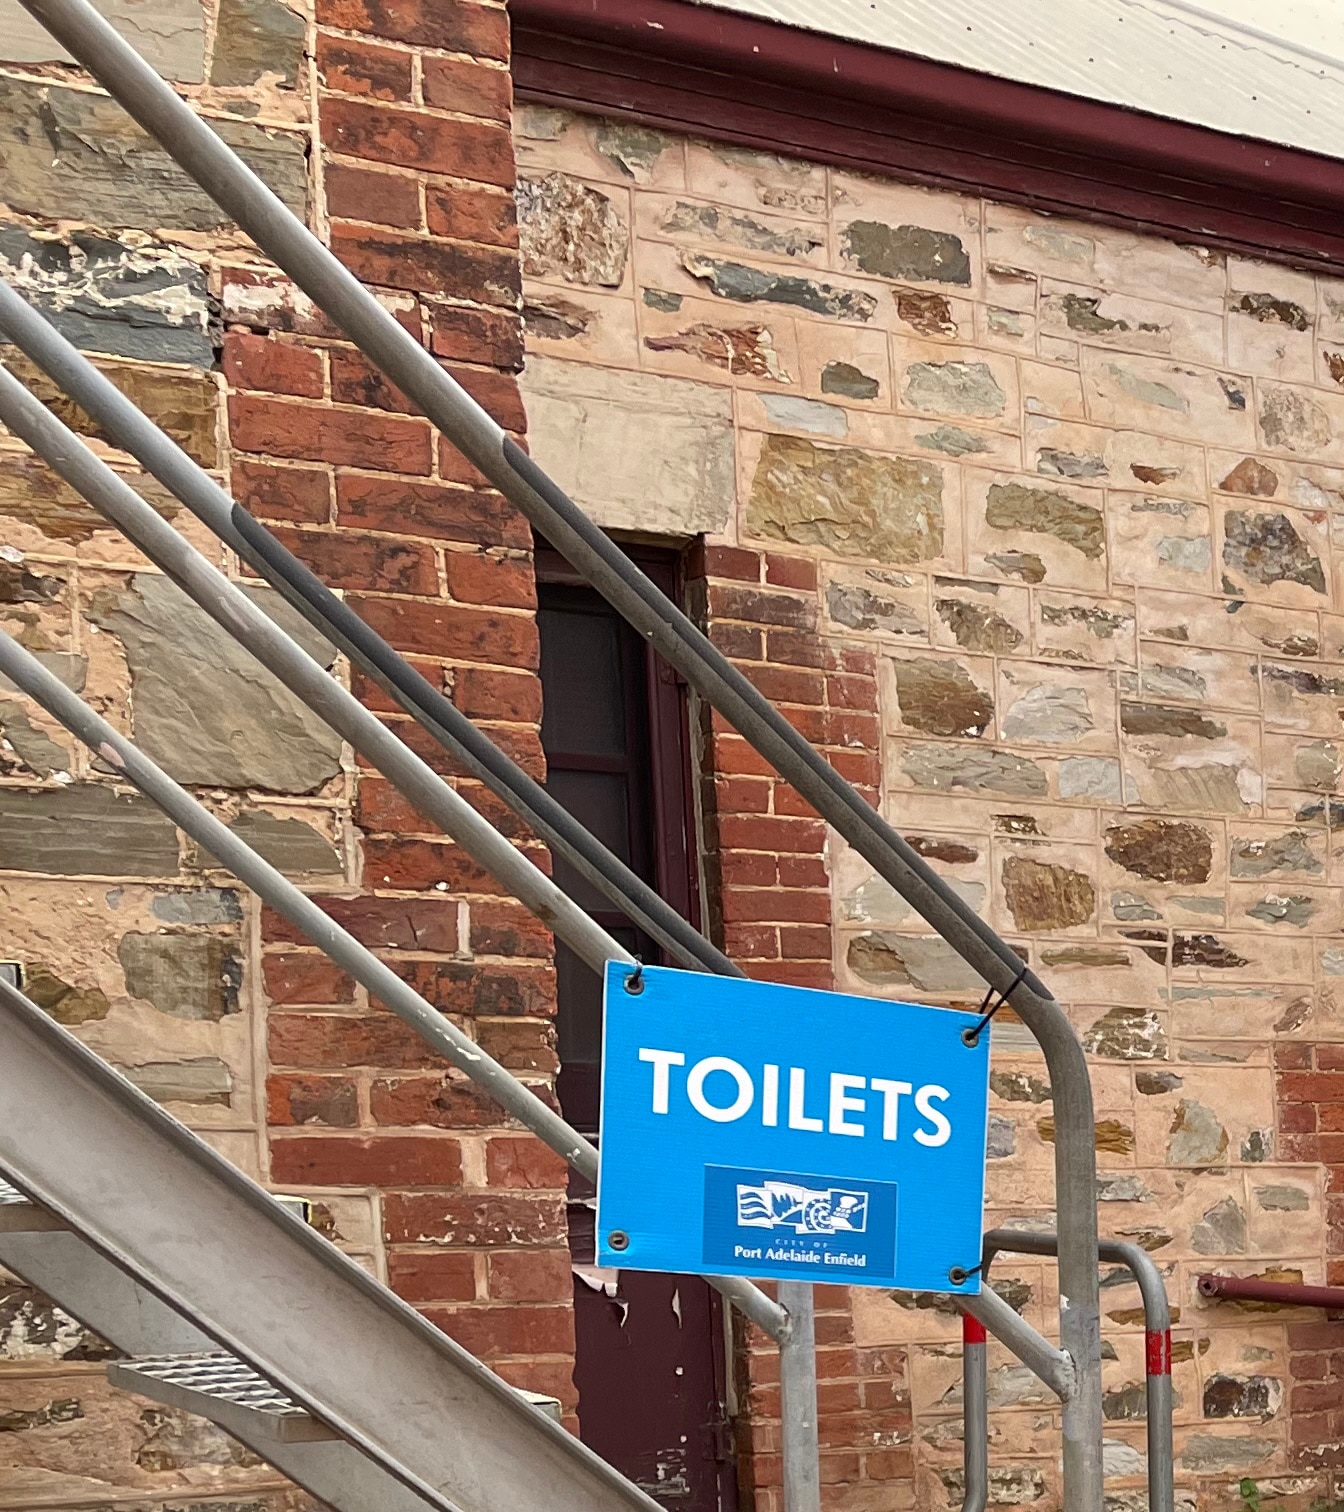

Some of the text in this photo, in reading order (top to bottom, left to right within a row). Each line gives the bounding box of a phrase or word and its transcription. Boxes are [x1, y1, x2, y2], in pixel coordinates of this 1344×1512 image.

[638, 1047, 952, 1148] TOILETS
[734, 1245, 867, 1267] Port Adelaide Enfield
